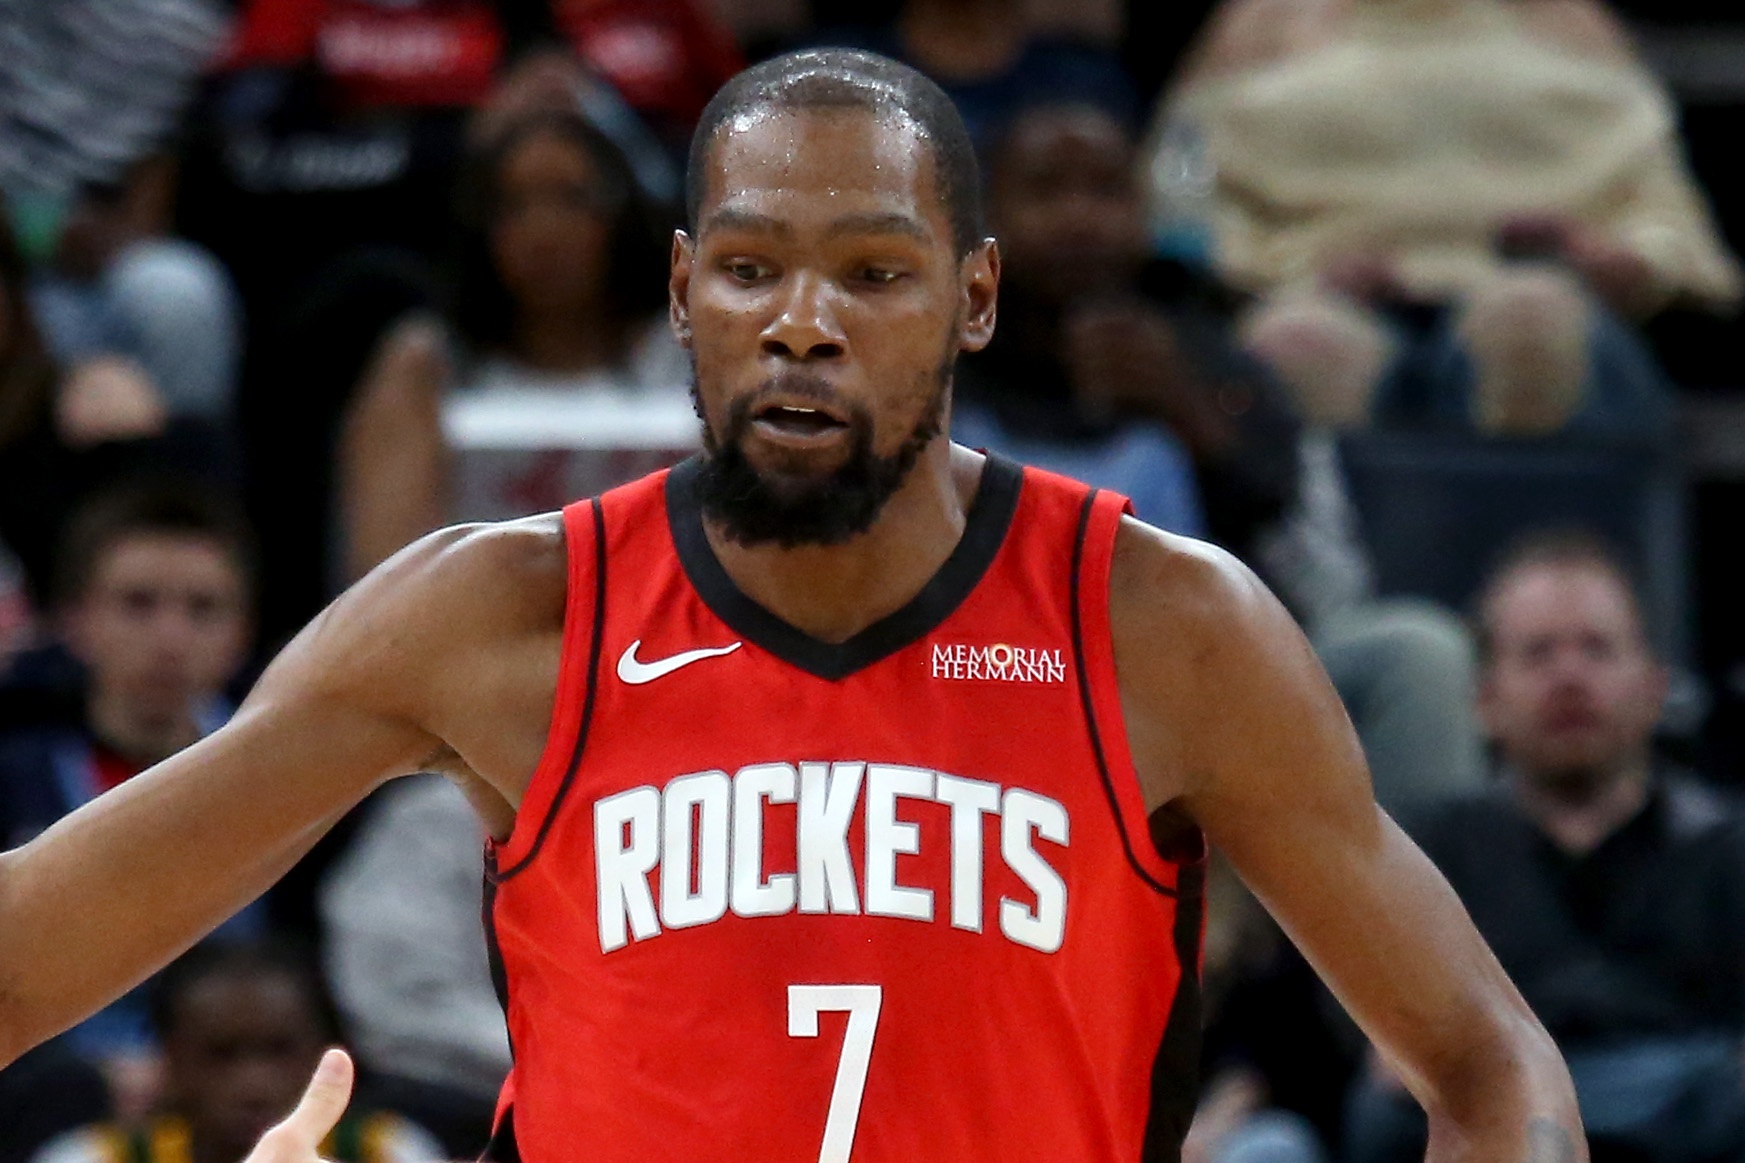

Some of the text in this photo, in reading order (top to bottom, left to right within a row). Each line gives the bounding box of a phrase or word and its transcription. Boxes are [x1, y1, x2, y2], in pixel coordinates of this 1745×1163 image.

[931, 643, 1066, 668] MEMORIAL
[931, 660, 1066, 683] HERMANN
[593, 760, 1071, 955] ROCKETS
